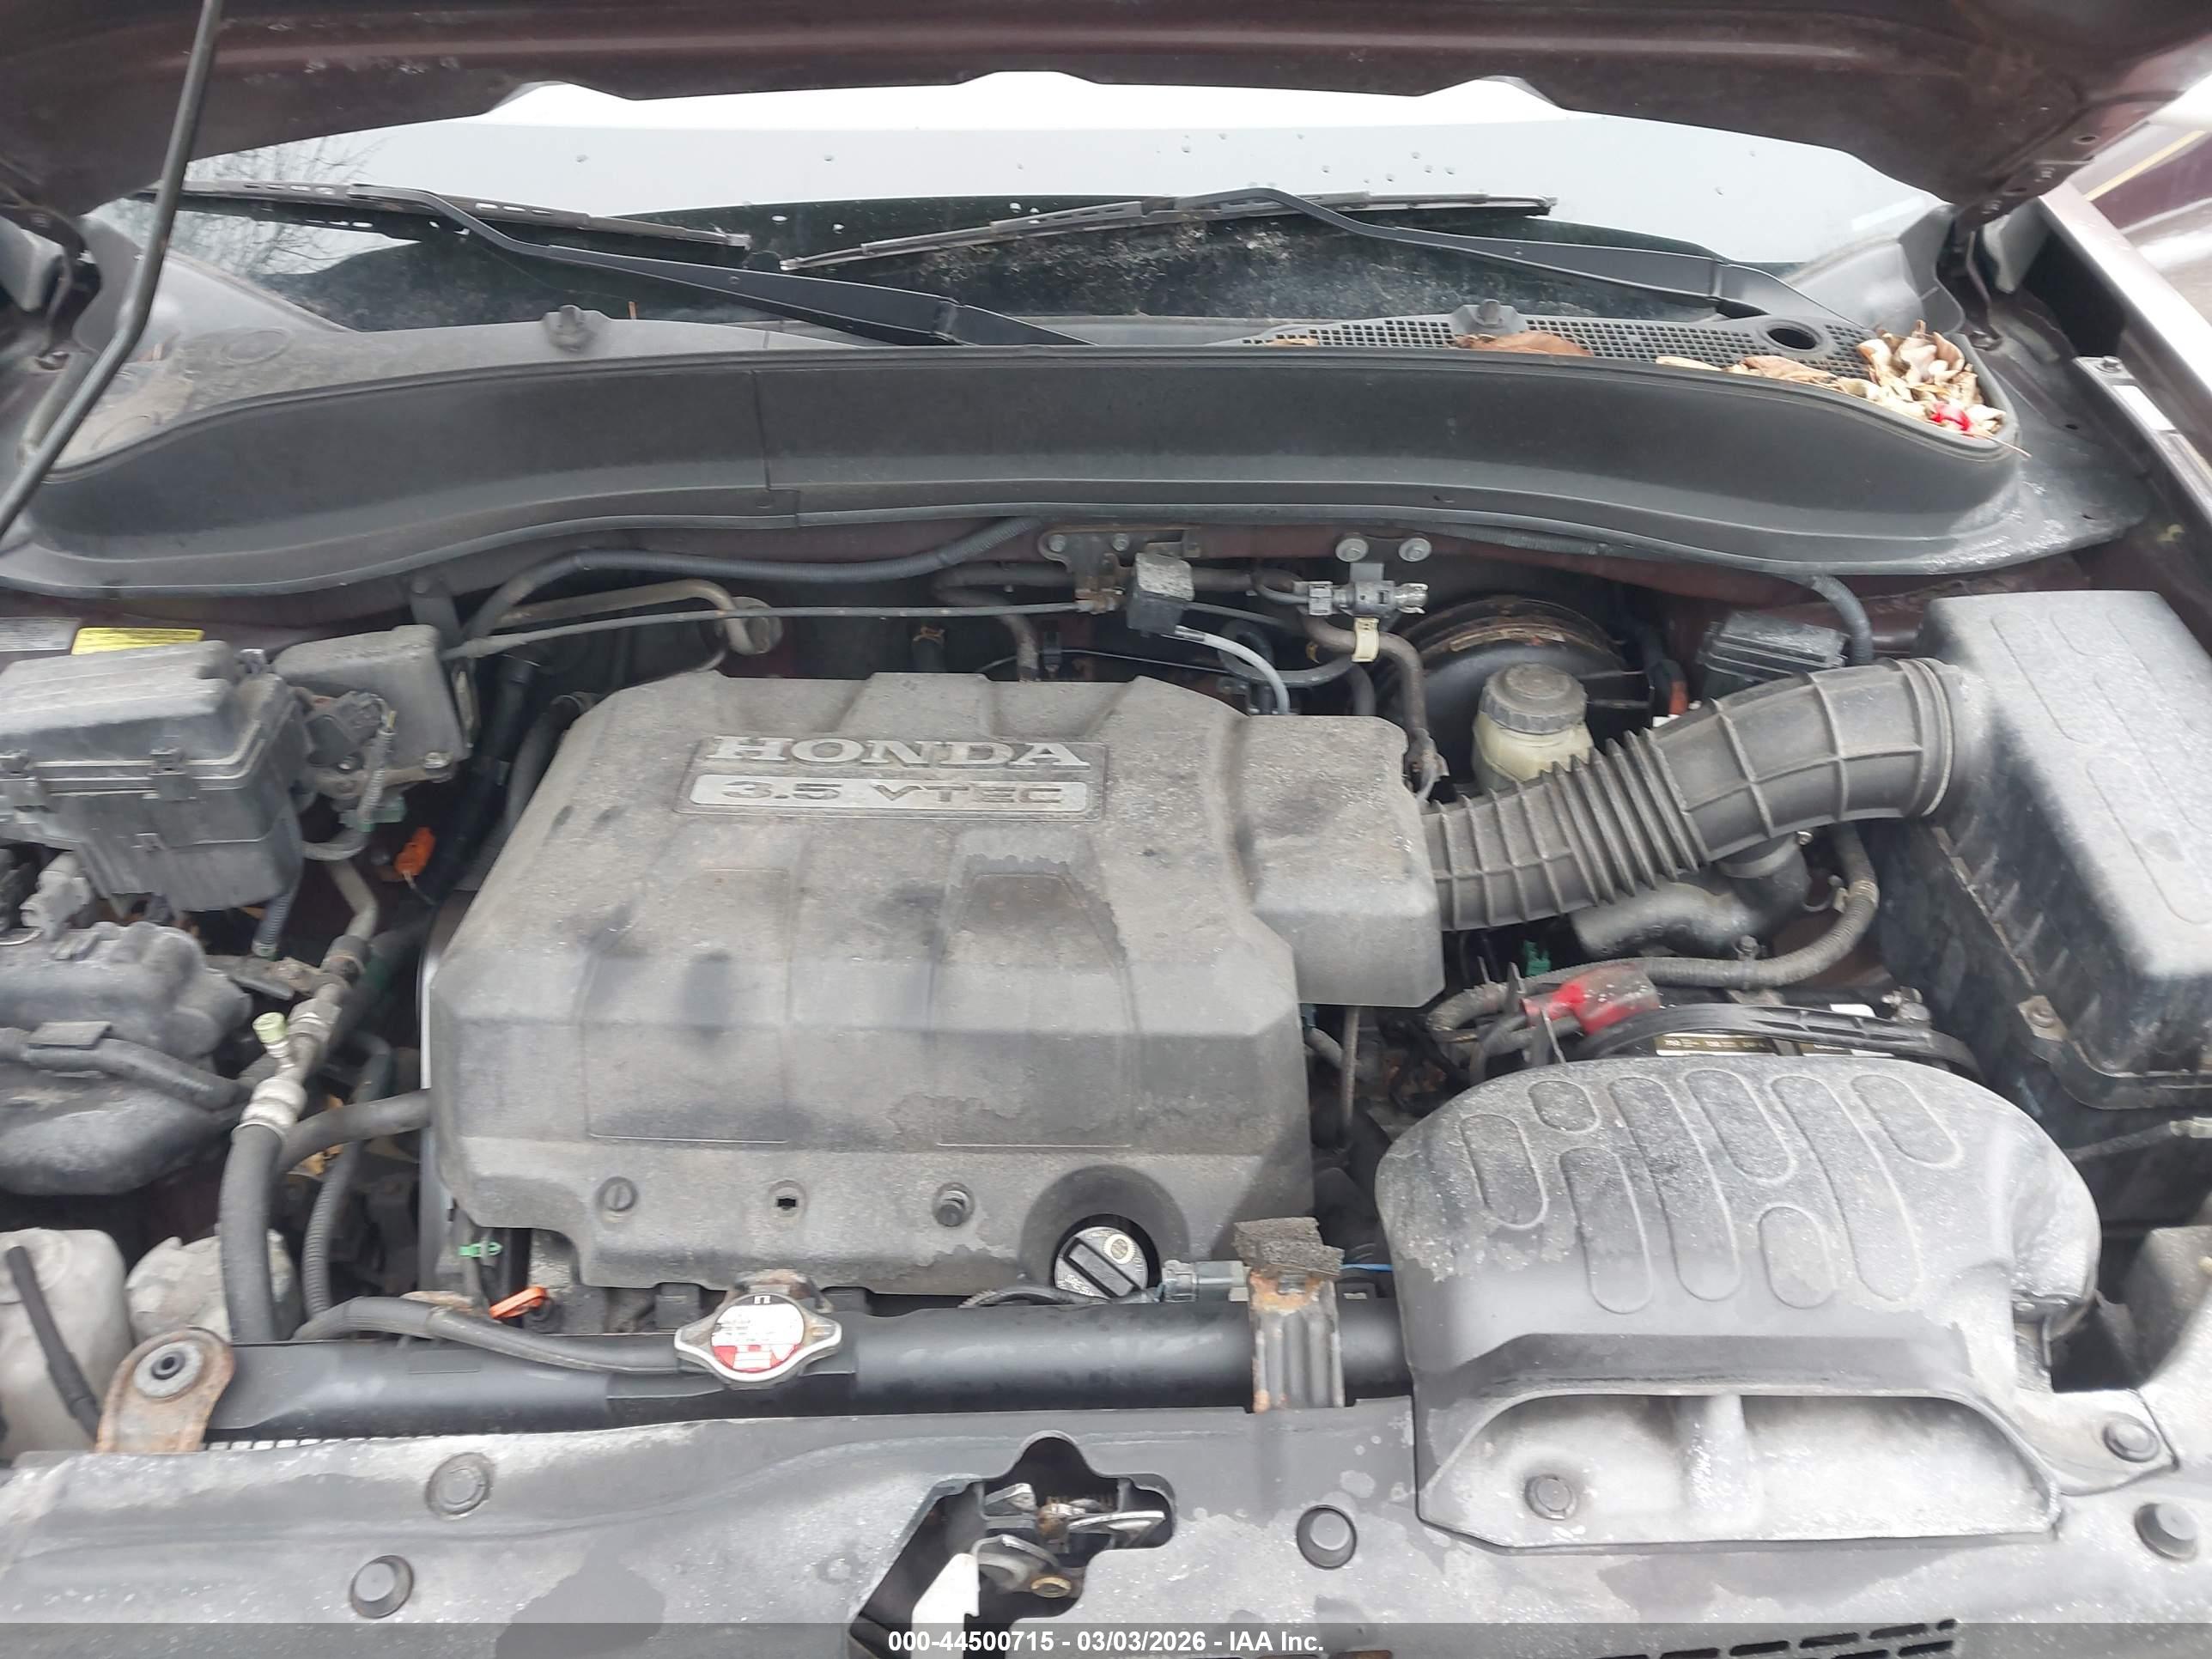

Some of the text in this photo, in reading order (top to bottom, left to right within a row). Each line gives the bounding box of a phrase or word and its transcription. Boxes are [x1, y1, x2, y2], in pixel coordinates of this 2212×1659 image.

[705, 736, 1091, 769] HONDA
[722, 781, 1061, 803] 3.5 VTEC
